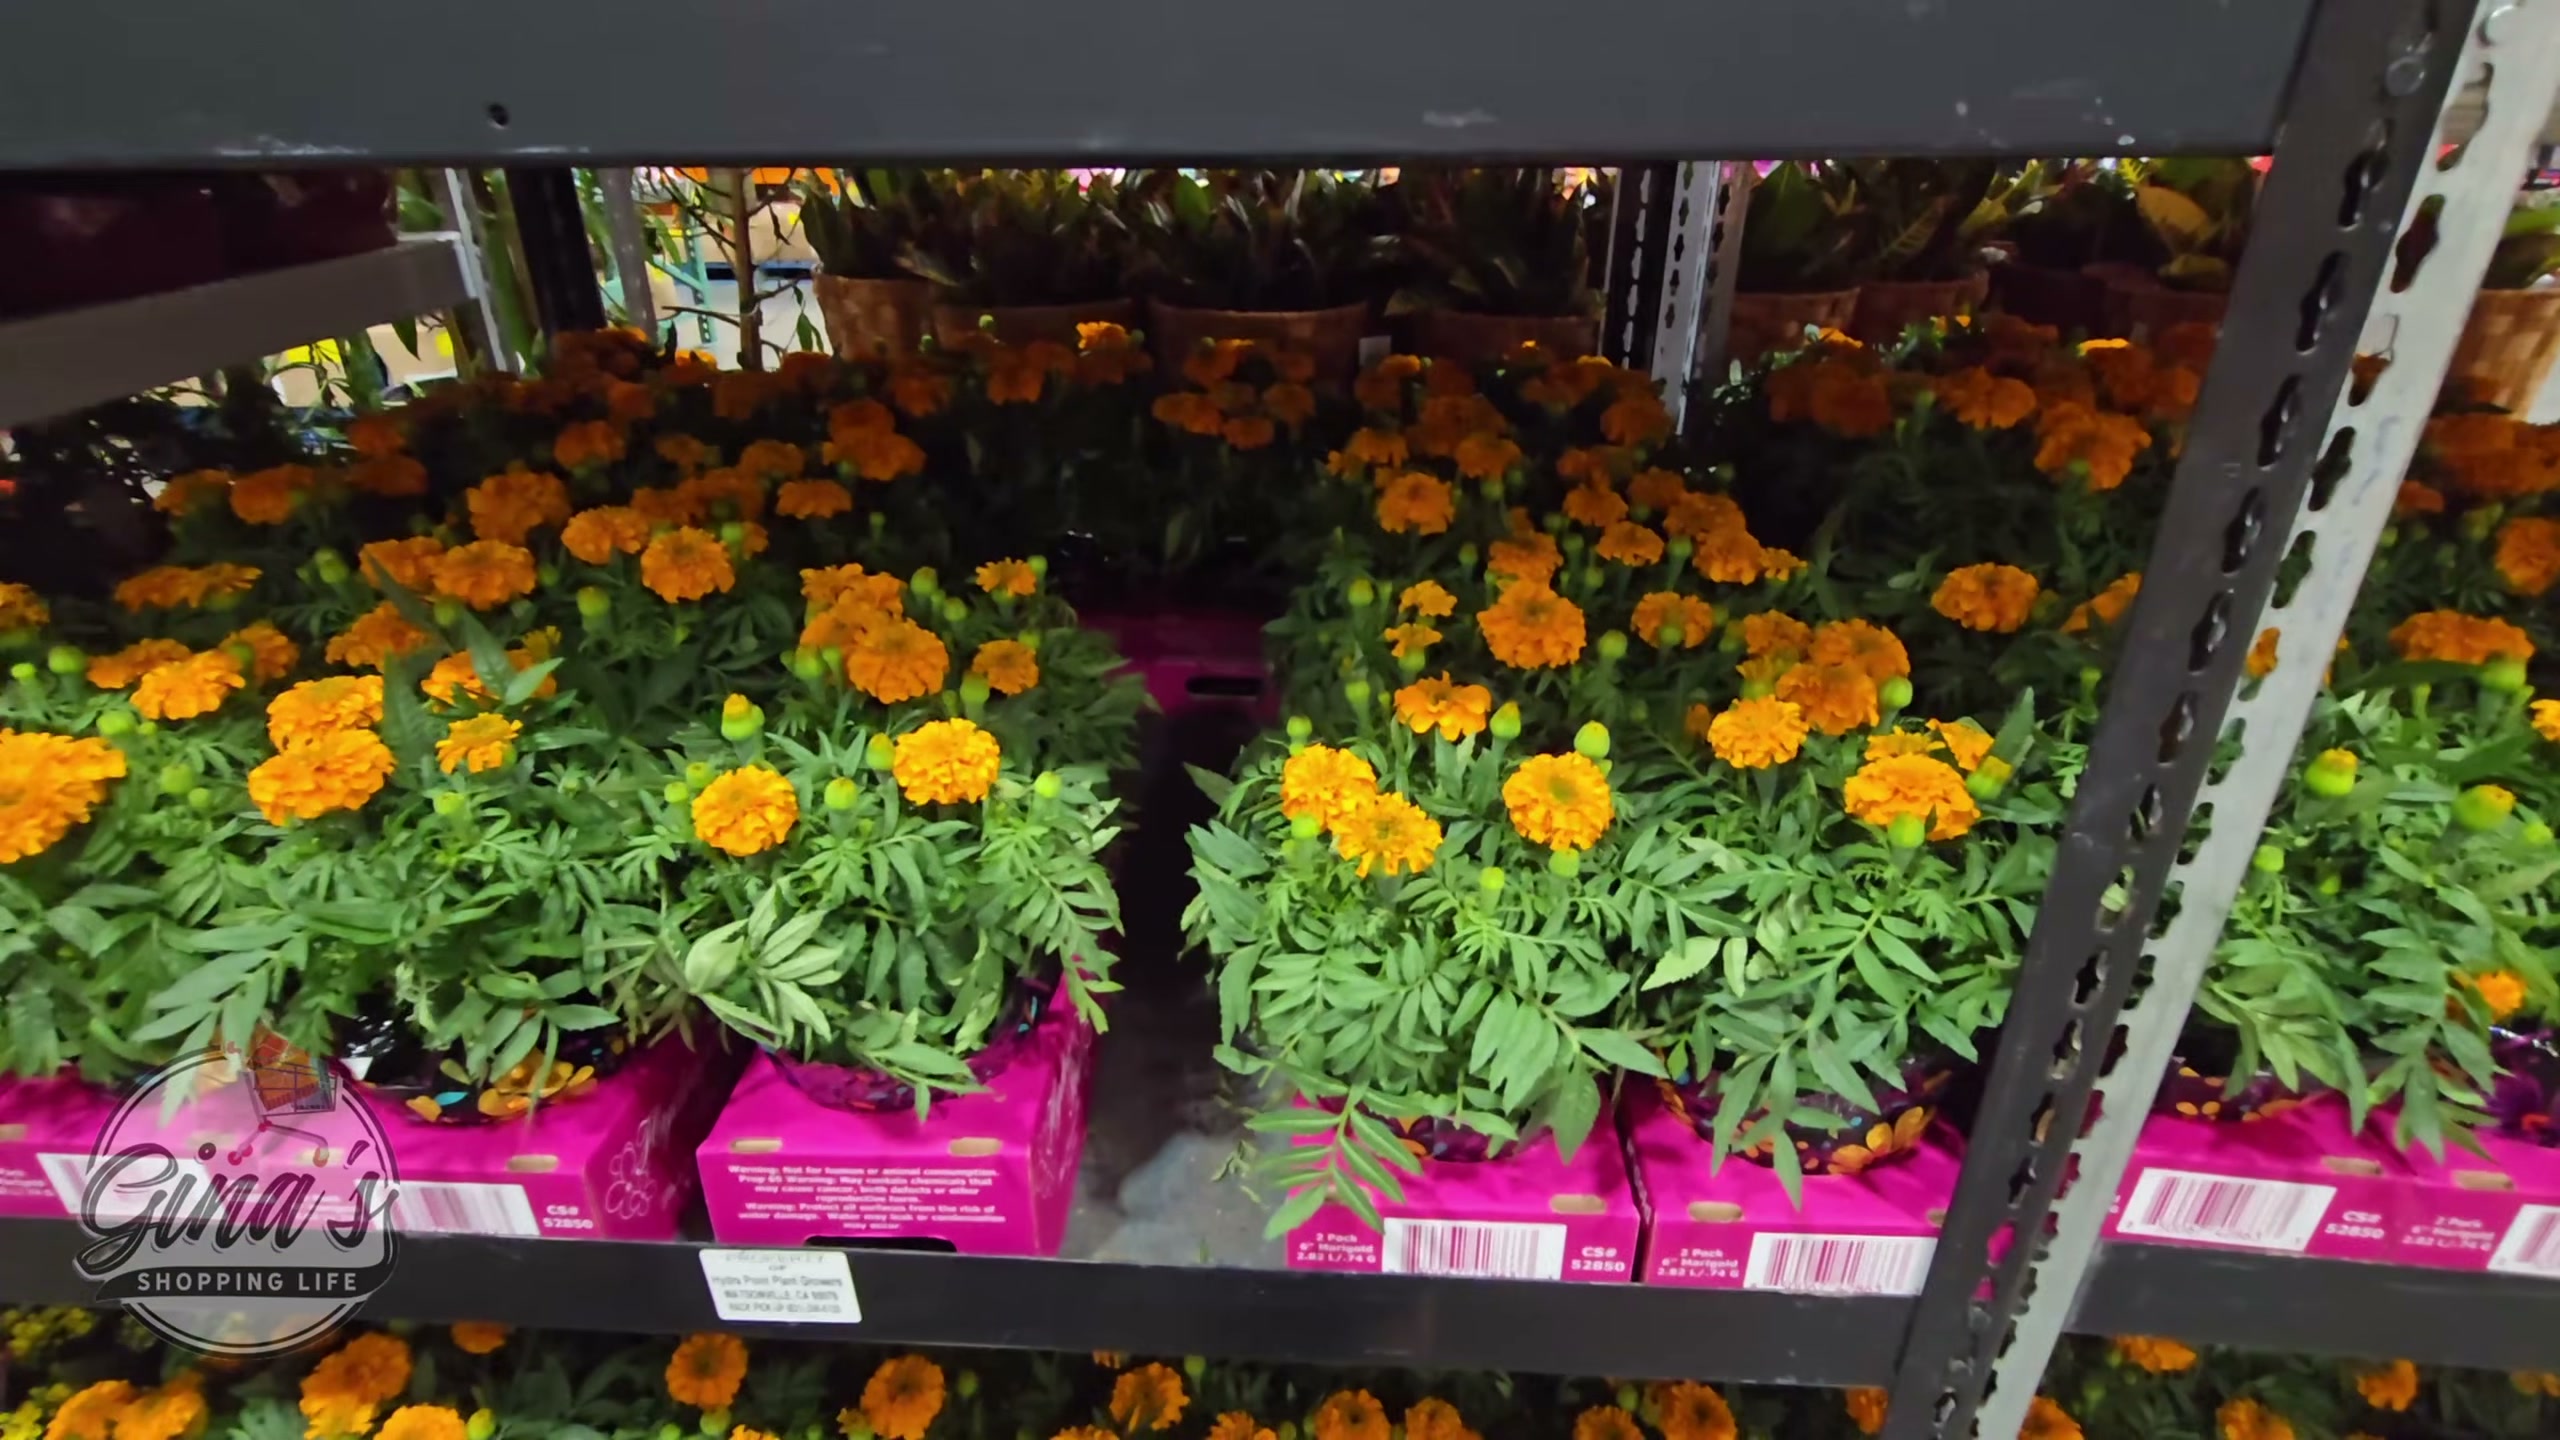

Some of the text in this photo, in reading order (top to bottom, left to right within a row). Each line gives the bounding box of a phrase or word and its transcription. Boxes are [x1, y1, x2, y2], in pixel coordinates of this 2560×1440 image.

[728, 1166, 778, 1177] Warning:
[782, 1166, 802, 1174] Not
[805, 1166, 821, 1174] for
[824, 1167, 864, 1175] human
[882, 1168, 920, 1176] animal
[738, 1175, 766, 1185] Prop
[786, 1176, 836, 1187] Warning:
[839, 1177, 863, 1186] May
[910, 1177, 966, 1186] chemicals
[968, 1178, 992, 1186] that
[754, 1186, 778, 1194] may
[861, 1186, 888, 1194] birth
[890, 1186, 931, 1195] defects
[948, 1187, 979, 1196] other
[745, 1203, 797, 1213] Warning:
[799, 1203, 839, 1211] Protect
[843, 1203, 856, 1211] all
[908, 1204, 936, 1213] from
[938, 1205, 957, 1213] the
[960, 1205, 981, 1213] risk
[983, 1205, 996, 1213] of
[863, 1214, 887, 1222] may
[2324, 1223, 2385, 1239] 52850
[1327, 1233, 1358, 1243] Pack
[1318, 1243, 1374, 1255] Marigold
[1581, 1246, 1618, 1258] CS#
[1692, 1248, 1724, 1258] Pack
[1571, 1259, 1626, 1272] 52850
[1681, 1258, 1738, 1270] Marigold
